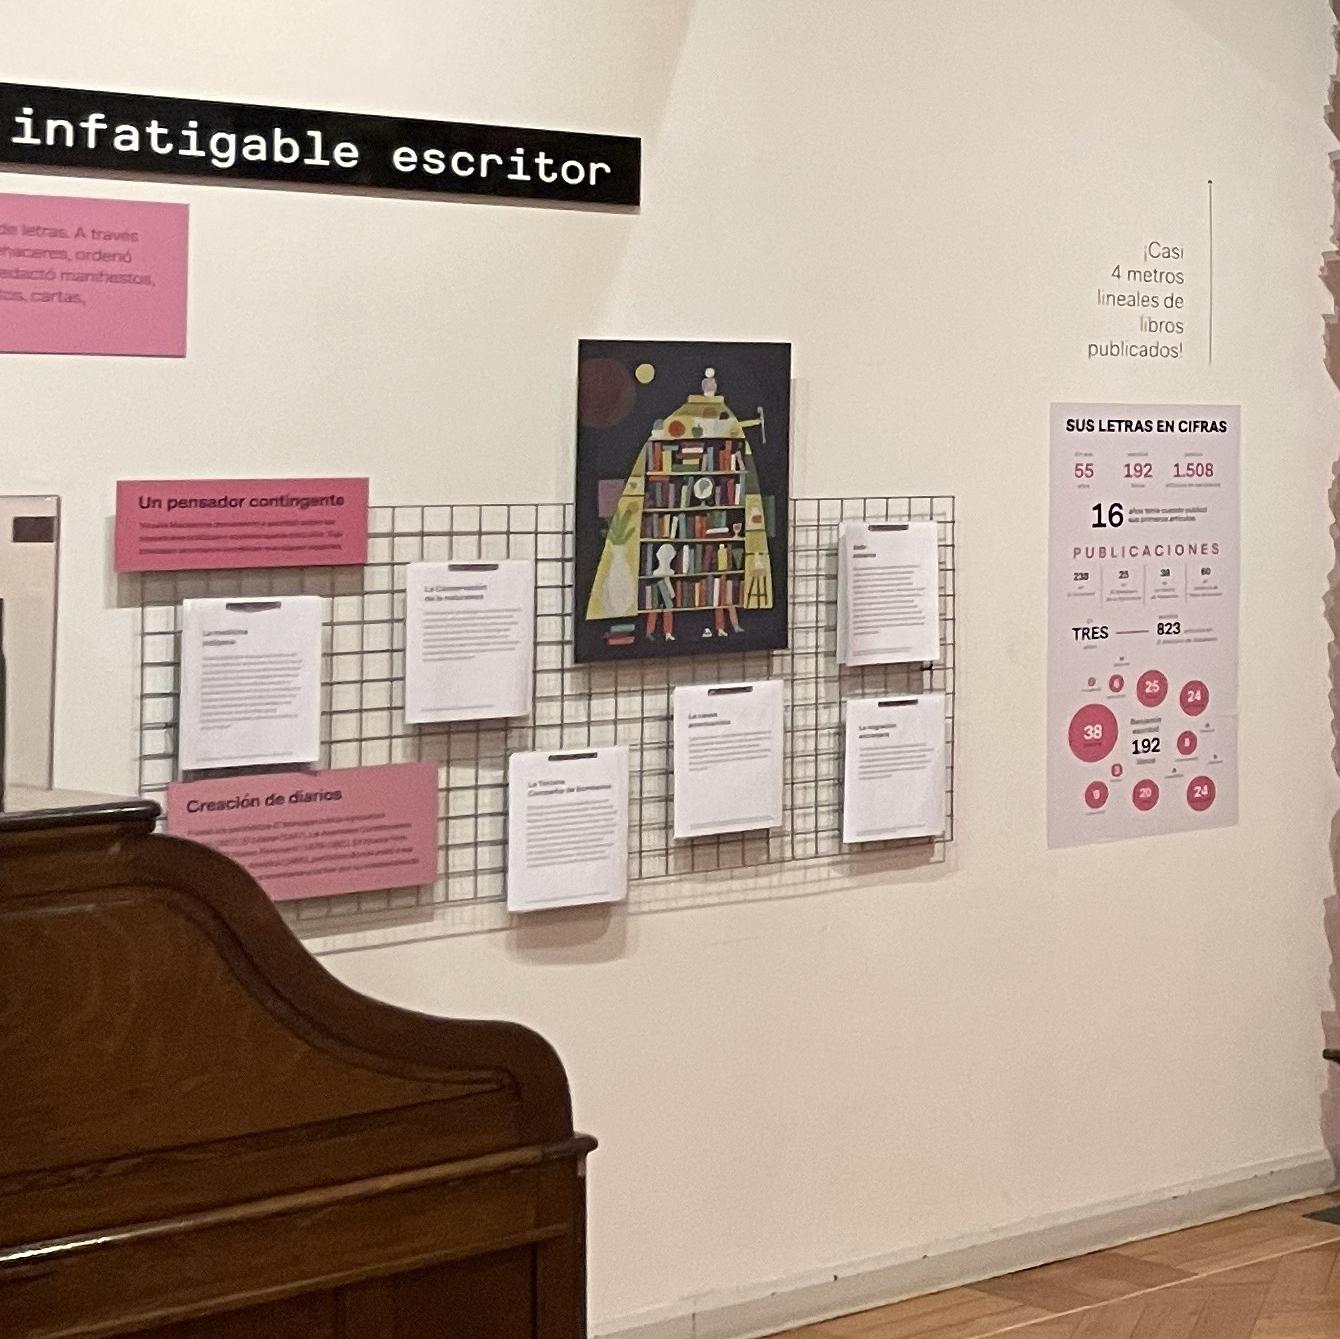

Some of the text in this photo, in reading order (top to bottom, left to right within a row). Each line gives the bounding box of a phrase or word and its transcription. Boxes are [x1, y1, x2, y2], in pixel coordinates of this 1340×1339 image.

[11, 107, 610, 187] infatigable escritor
[74, 226, 87, 239] A
[91, 228, 139, 242] través
[75, 249, 132, 263] ordenó
[1144, 241, 1184, 261] ¡Casi
[1112, 264, 1185, 285] 4 metros
[31, 291, 86, 306] cartas,
[1097, 288, 1184, 309] lineales de
[1140, 315, 1184, 334] libros
[1088, 340, 1183, 360] publicados!
[1066, 419, 1228, 433] SUS LETRAS EN CIFRAS
[1074, 463, 1214, 478] 55 192 1.508
[139, 494, 344, 512] Un pensador contingente
[1092, 503, 1124, 528] 16
[1073, 543, 1220, 559] PUBLICACIONES
[1072, 622, 1181, 640] TRES 823
[1145, 680, 1160, 693] 25
[1188, 690, 1201, 702] 24
[1083, 724, 1103, 740] 38
[1132, 738, 1160, 754] 192
[186, 789, 342, 813] Creación de diarios
